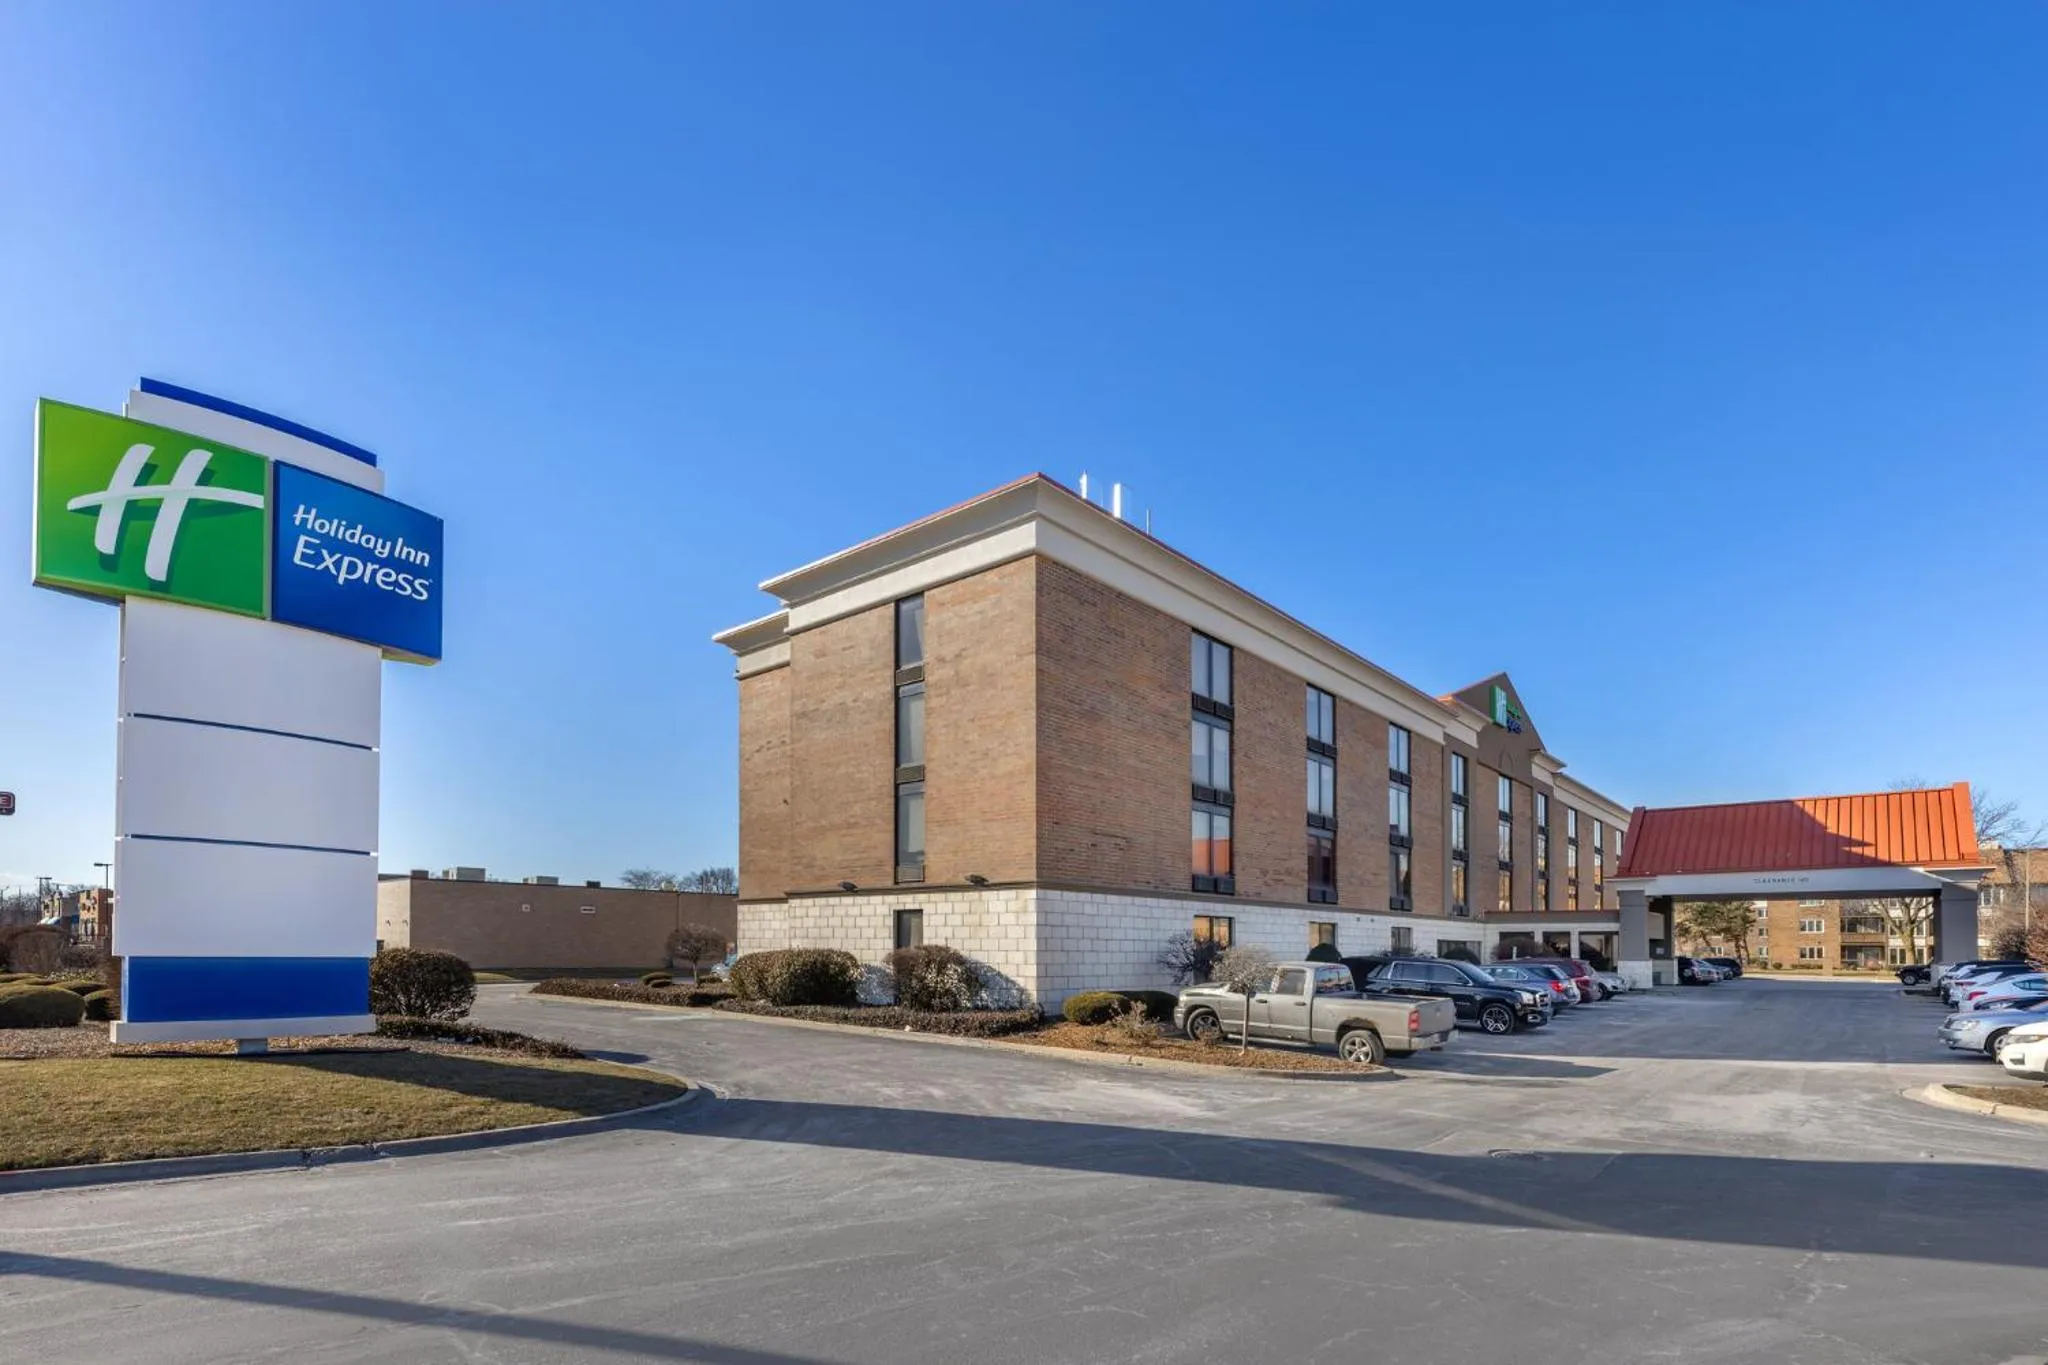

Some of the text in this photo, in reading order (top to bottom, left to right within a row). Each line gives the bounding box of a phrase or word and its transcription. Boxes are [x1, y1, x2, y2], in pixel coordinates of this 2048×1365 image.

[67, 443, 264, 582] H
[293, 504, 431, 568] Holiday Inn
[293, 534, 430, 601] Express
